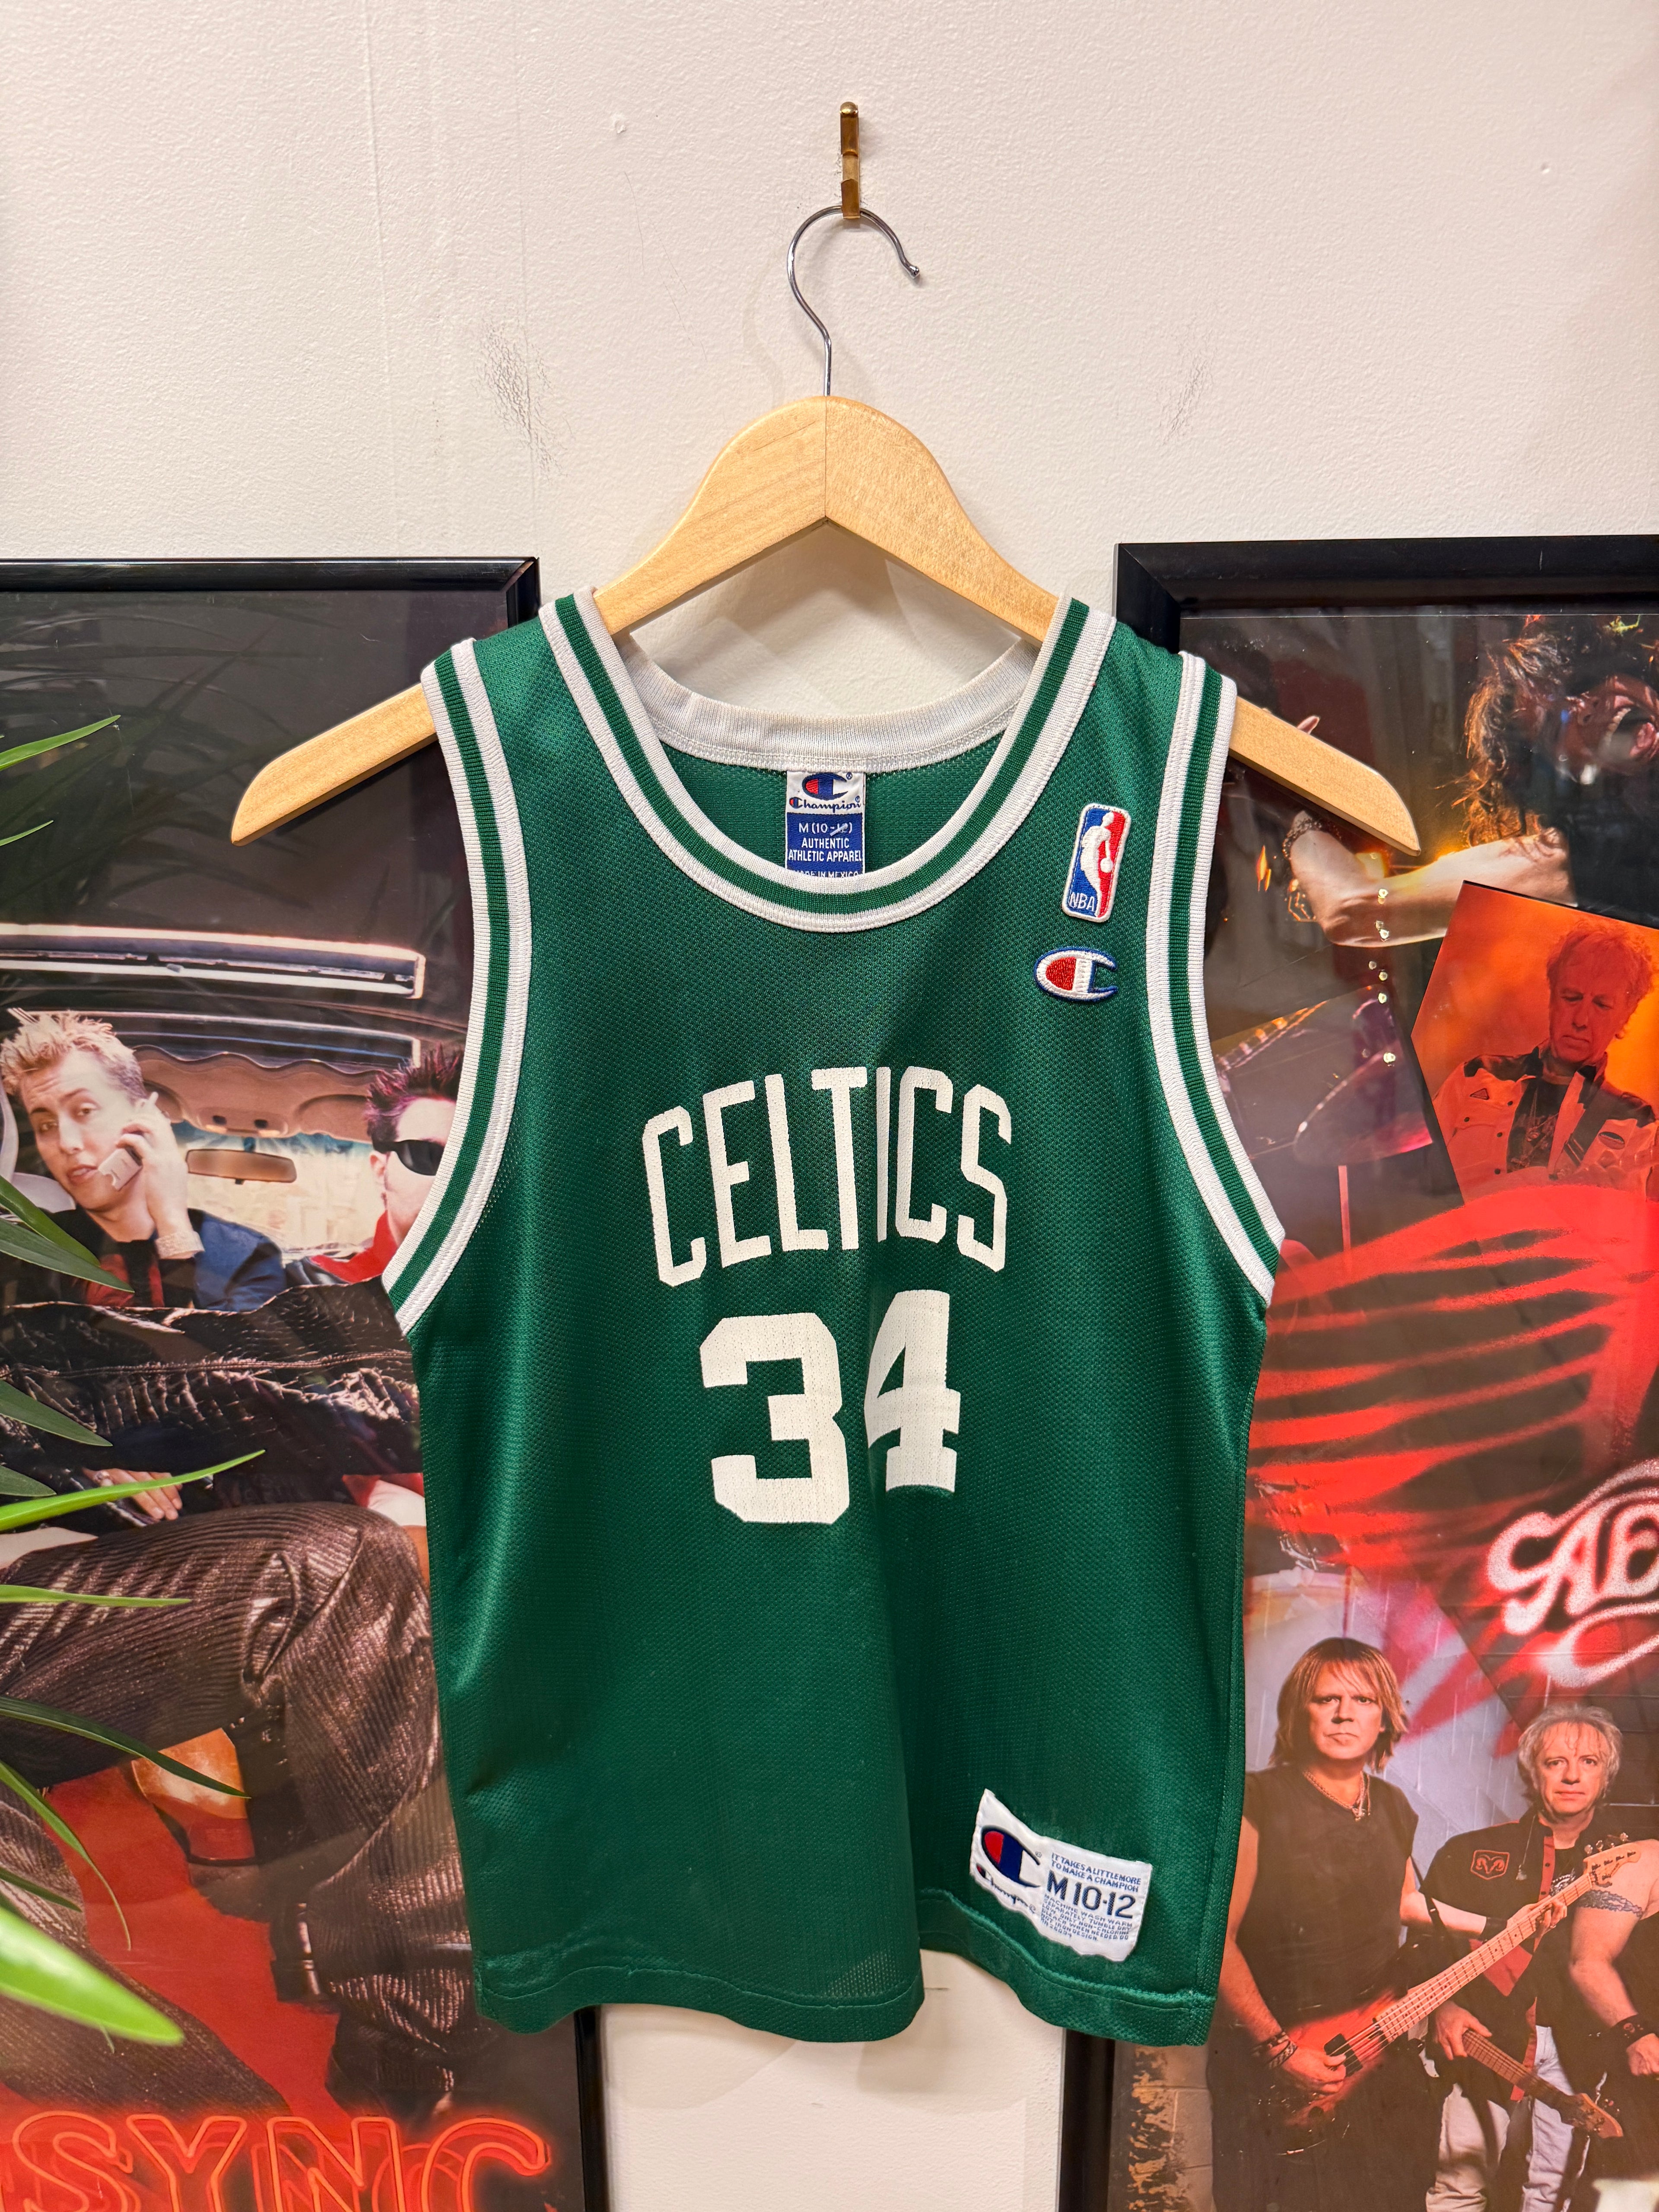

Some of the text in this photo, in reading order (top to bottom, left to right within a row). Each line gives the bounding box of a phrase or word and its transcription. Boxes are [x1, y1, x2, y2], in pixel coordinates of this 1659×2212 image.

[789, 797, 861, 813] Champion
[799, 823, 809, 833] M
[801, 837, 849, 849] AUTHENTIC
[788, 849, 862, 862] ATHLETIC APPAREL
[1069, 892, 1096, 912] NBA
[642, 1066, 1011, 1287] CELTICS
[699, 1290, 960, 1524] 34
[1061, 1856, 1085, 1871] TAKES
[1051, 1859, 1061, 1869] TO
[1062, 1866, 1085, 1878] MAKE
[1094, 1876, 1139, 1892] CHAMPION
[1047, 1870, 1136, 1919] M 10-12
[1081, 1911, 1105, 1922] WASH
[1108, 1919, 1132, 1927] WARM
